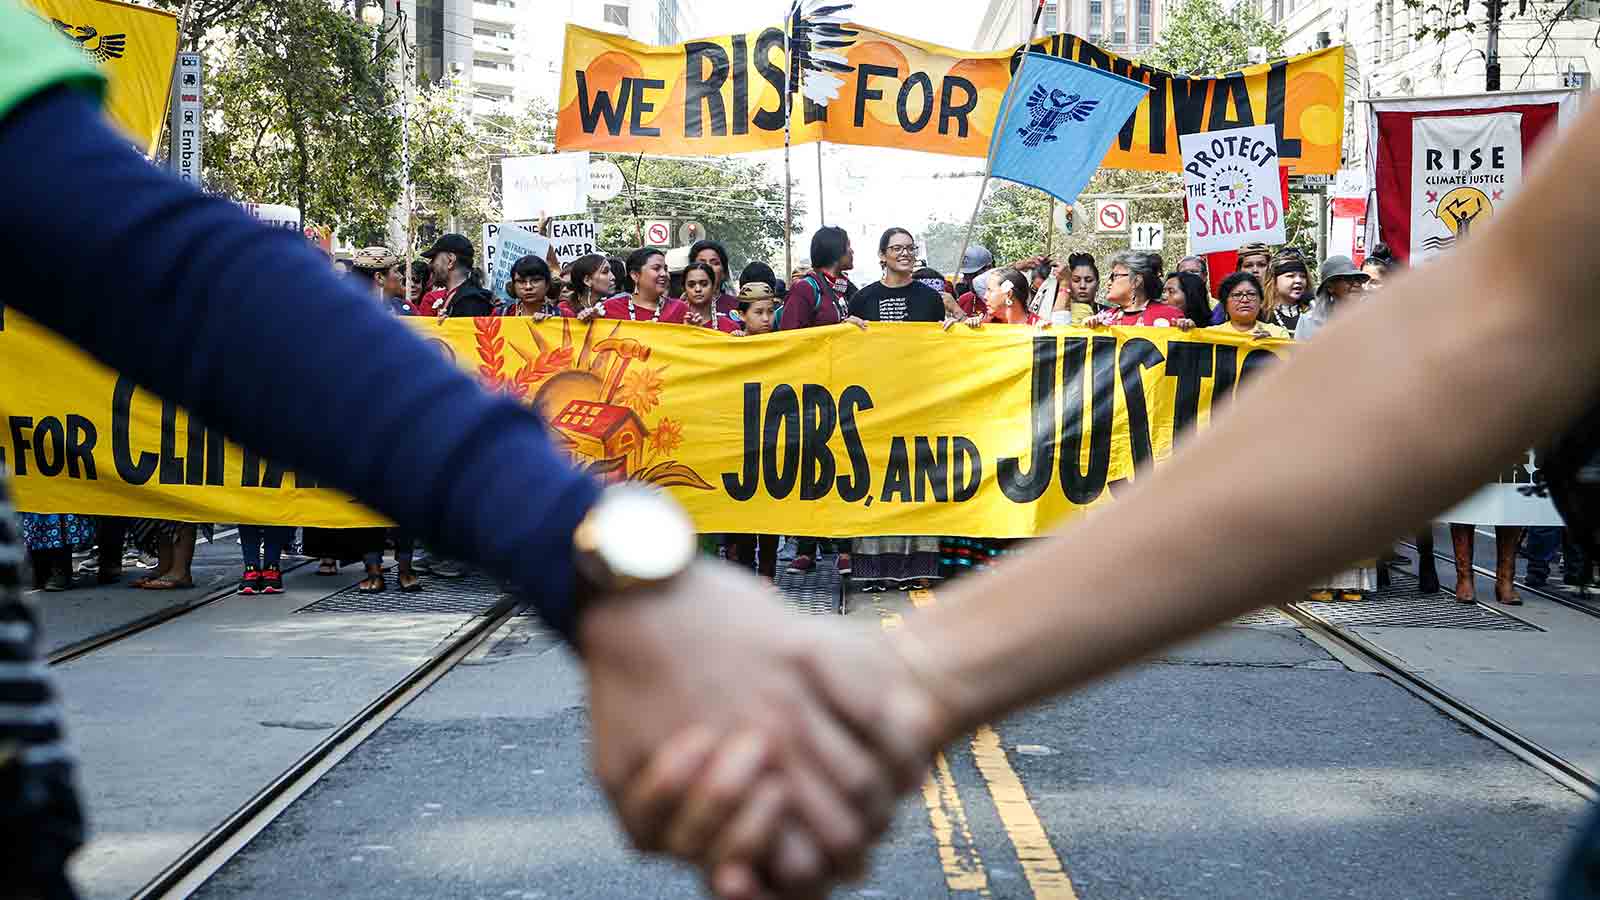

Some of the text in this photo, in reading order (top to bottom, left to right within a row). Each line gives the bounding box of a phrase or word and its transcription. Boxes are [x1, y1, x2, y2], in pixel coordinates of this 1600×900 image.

[576, 70, 664, 136] WE
[684, 27, 828, 137] RIS
[853, 64, 978, 137] FOR
[1185, 136, 1277, 179] PROTECT
[1426, 147, 1505, 170] RISE
[1187, 182, 1207, 197] THE
[1425, 174, 1505, 185] CLIMATE JUSTICE
[553, 223, 594, 240] EARTH
[1196, 196, 1279, 237] SACRED
[9, 414, 97, 480] FOR
[721, 382, 874, 507] JOBS,
[880, 436, 982, 503] AND
